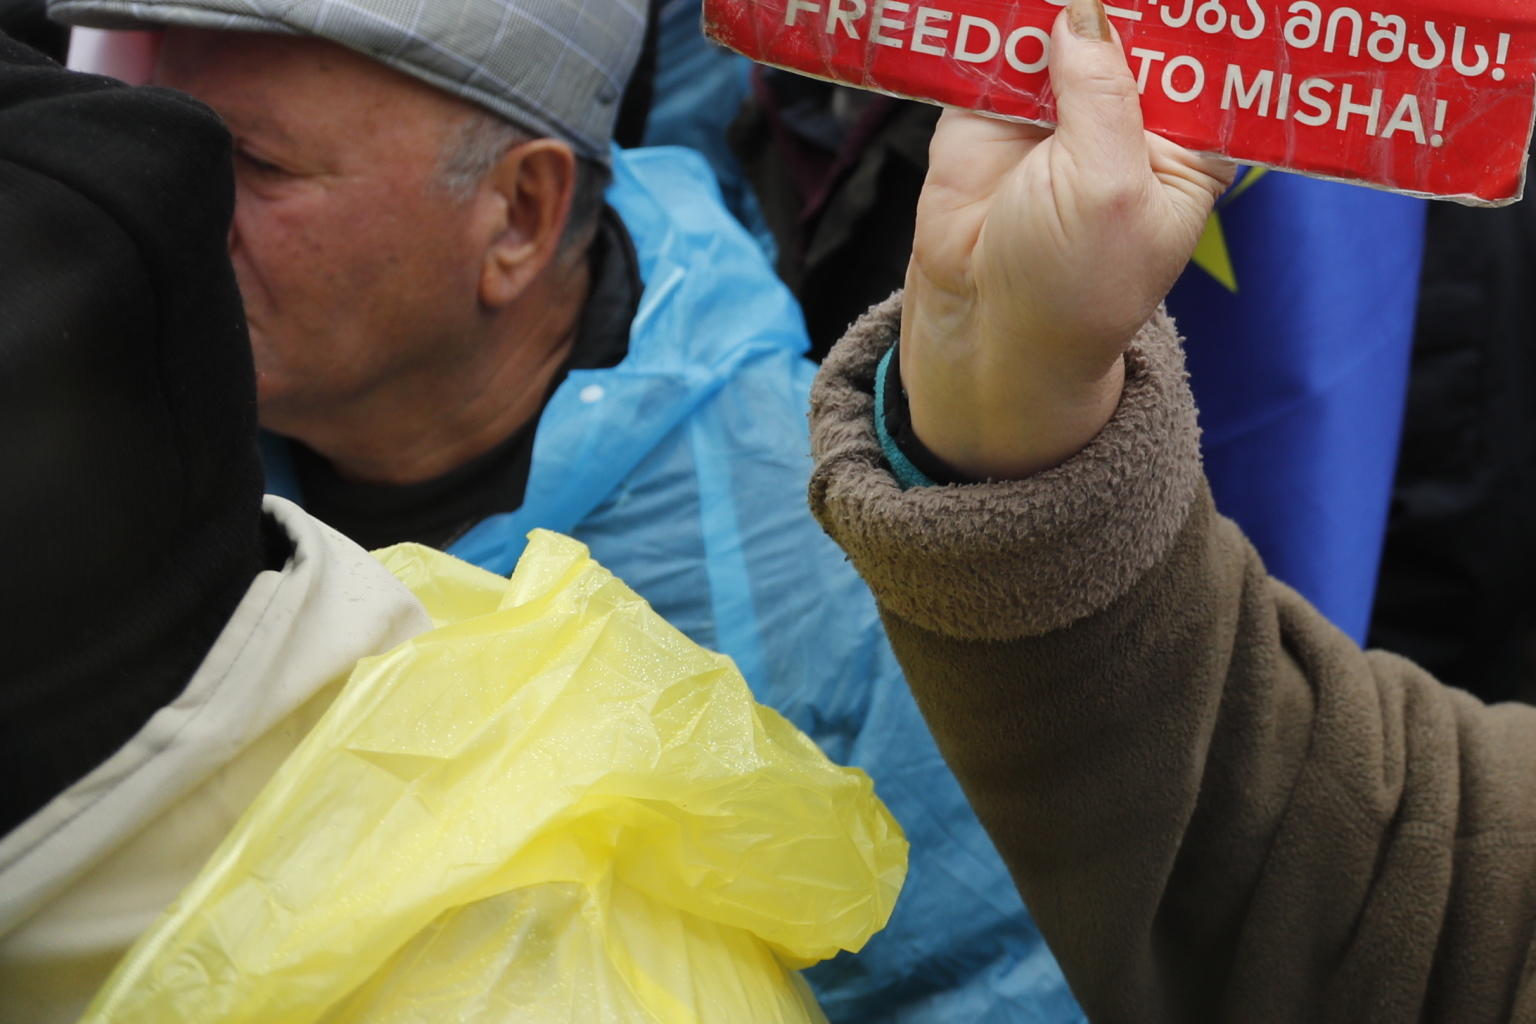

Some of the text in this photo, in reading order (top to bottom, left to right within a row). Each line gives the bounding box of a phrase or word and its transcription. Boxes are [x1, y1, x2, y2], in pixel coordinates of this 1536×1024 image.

[1283, 0, 1511, 82] მიშას!
[1130, 46, 1206, 104] TO
[1220, 63, 1449, 148] MISHA!
